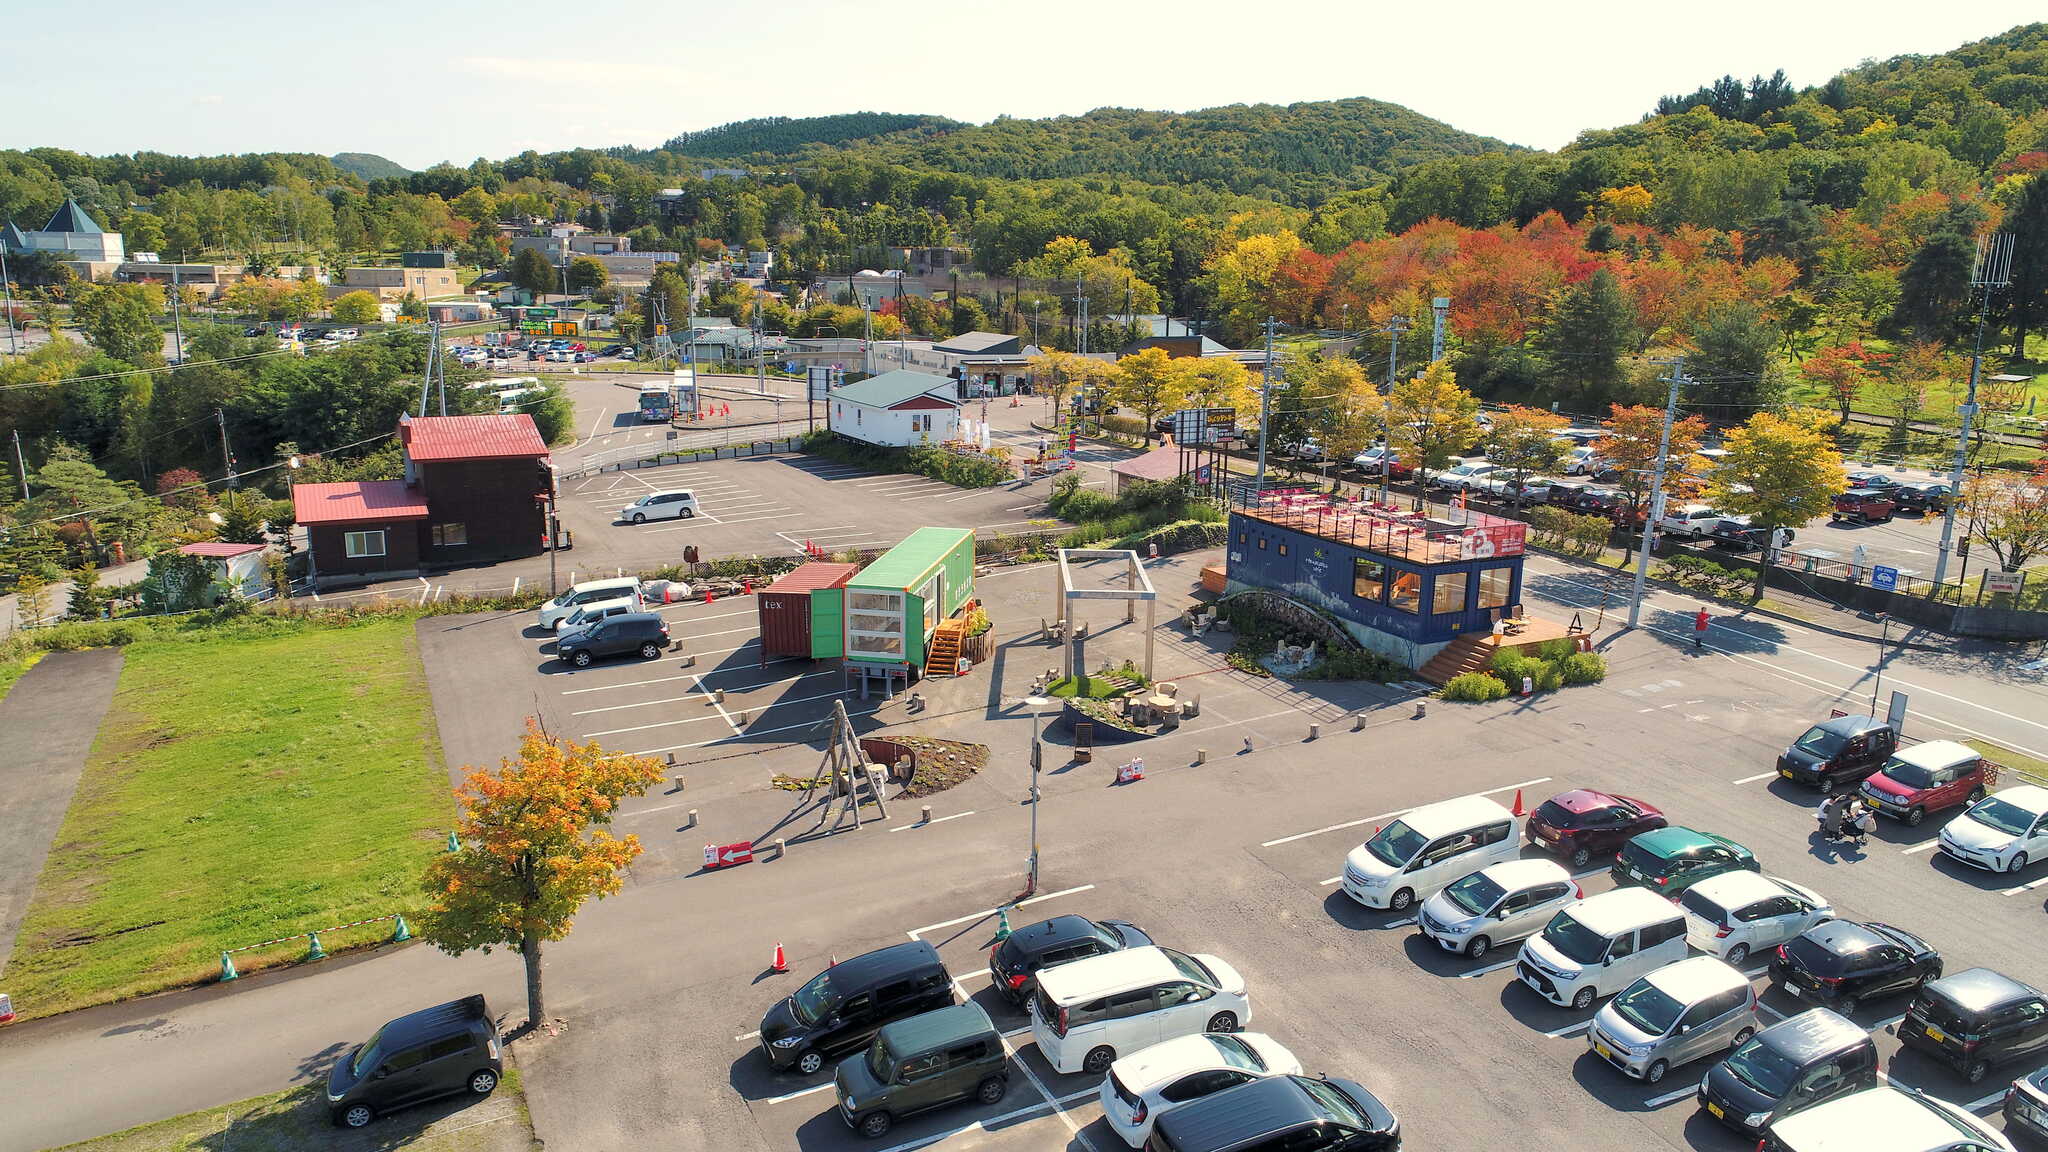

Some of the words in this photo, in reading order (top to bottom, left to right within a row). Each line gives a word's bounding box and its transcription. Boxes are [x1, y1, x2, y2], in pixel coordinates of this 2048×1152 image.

[1201, 469, 1208, 478] P
[1472, 535, 1485, 555] P
[765, 600, 783, 609] tex
